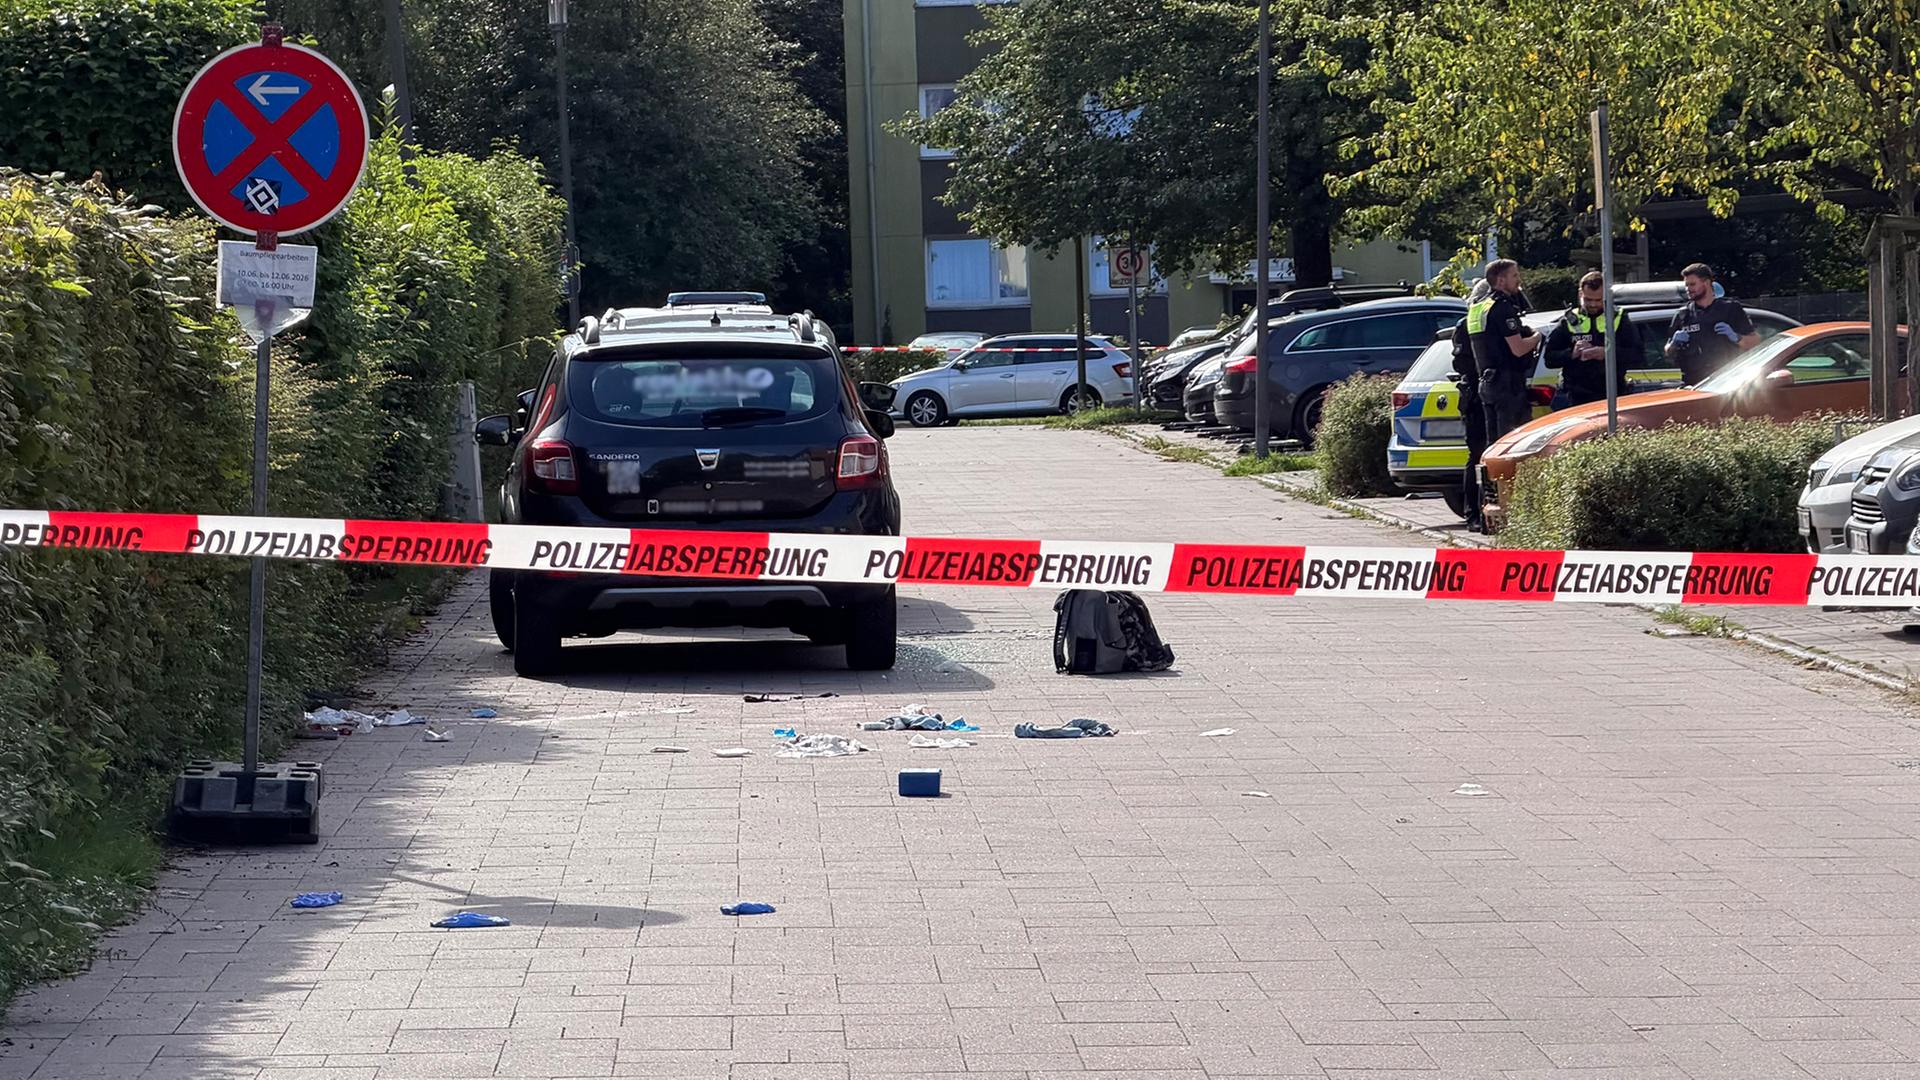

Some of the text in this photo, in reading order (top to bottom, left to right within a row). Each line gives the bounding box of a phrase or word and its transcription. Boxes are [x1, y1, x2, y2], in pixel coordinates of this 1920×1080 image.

[240, 250, 308, 261] Baumpflegearbeiten
[259, 271, 270, 279] bis
[281, 282, 295, 290] Uhr
[589, 453, 640, 461] SANDERO
[185, 529, 493, 565] POLIZEIABSPERRUNG
[529, 541, 827, 577] POLIZEIABSPERRUNG
[864, 550, 1152, 585] POLIZEIABSPERRUNG
[1187, 556, 1468, 592] POLIZEIABSPERRUNG
[1500, 562, 1774, 596] POLIZEIABSPERRUNG
[1806, 566, 1920, 596] POLIZEIA
